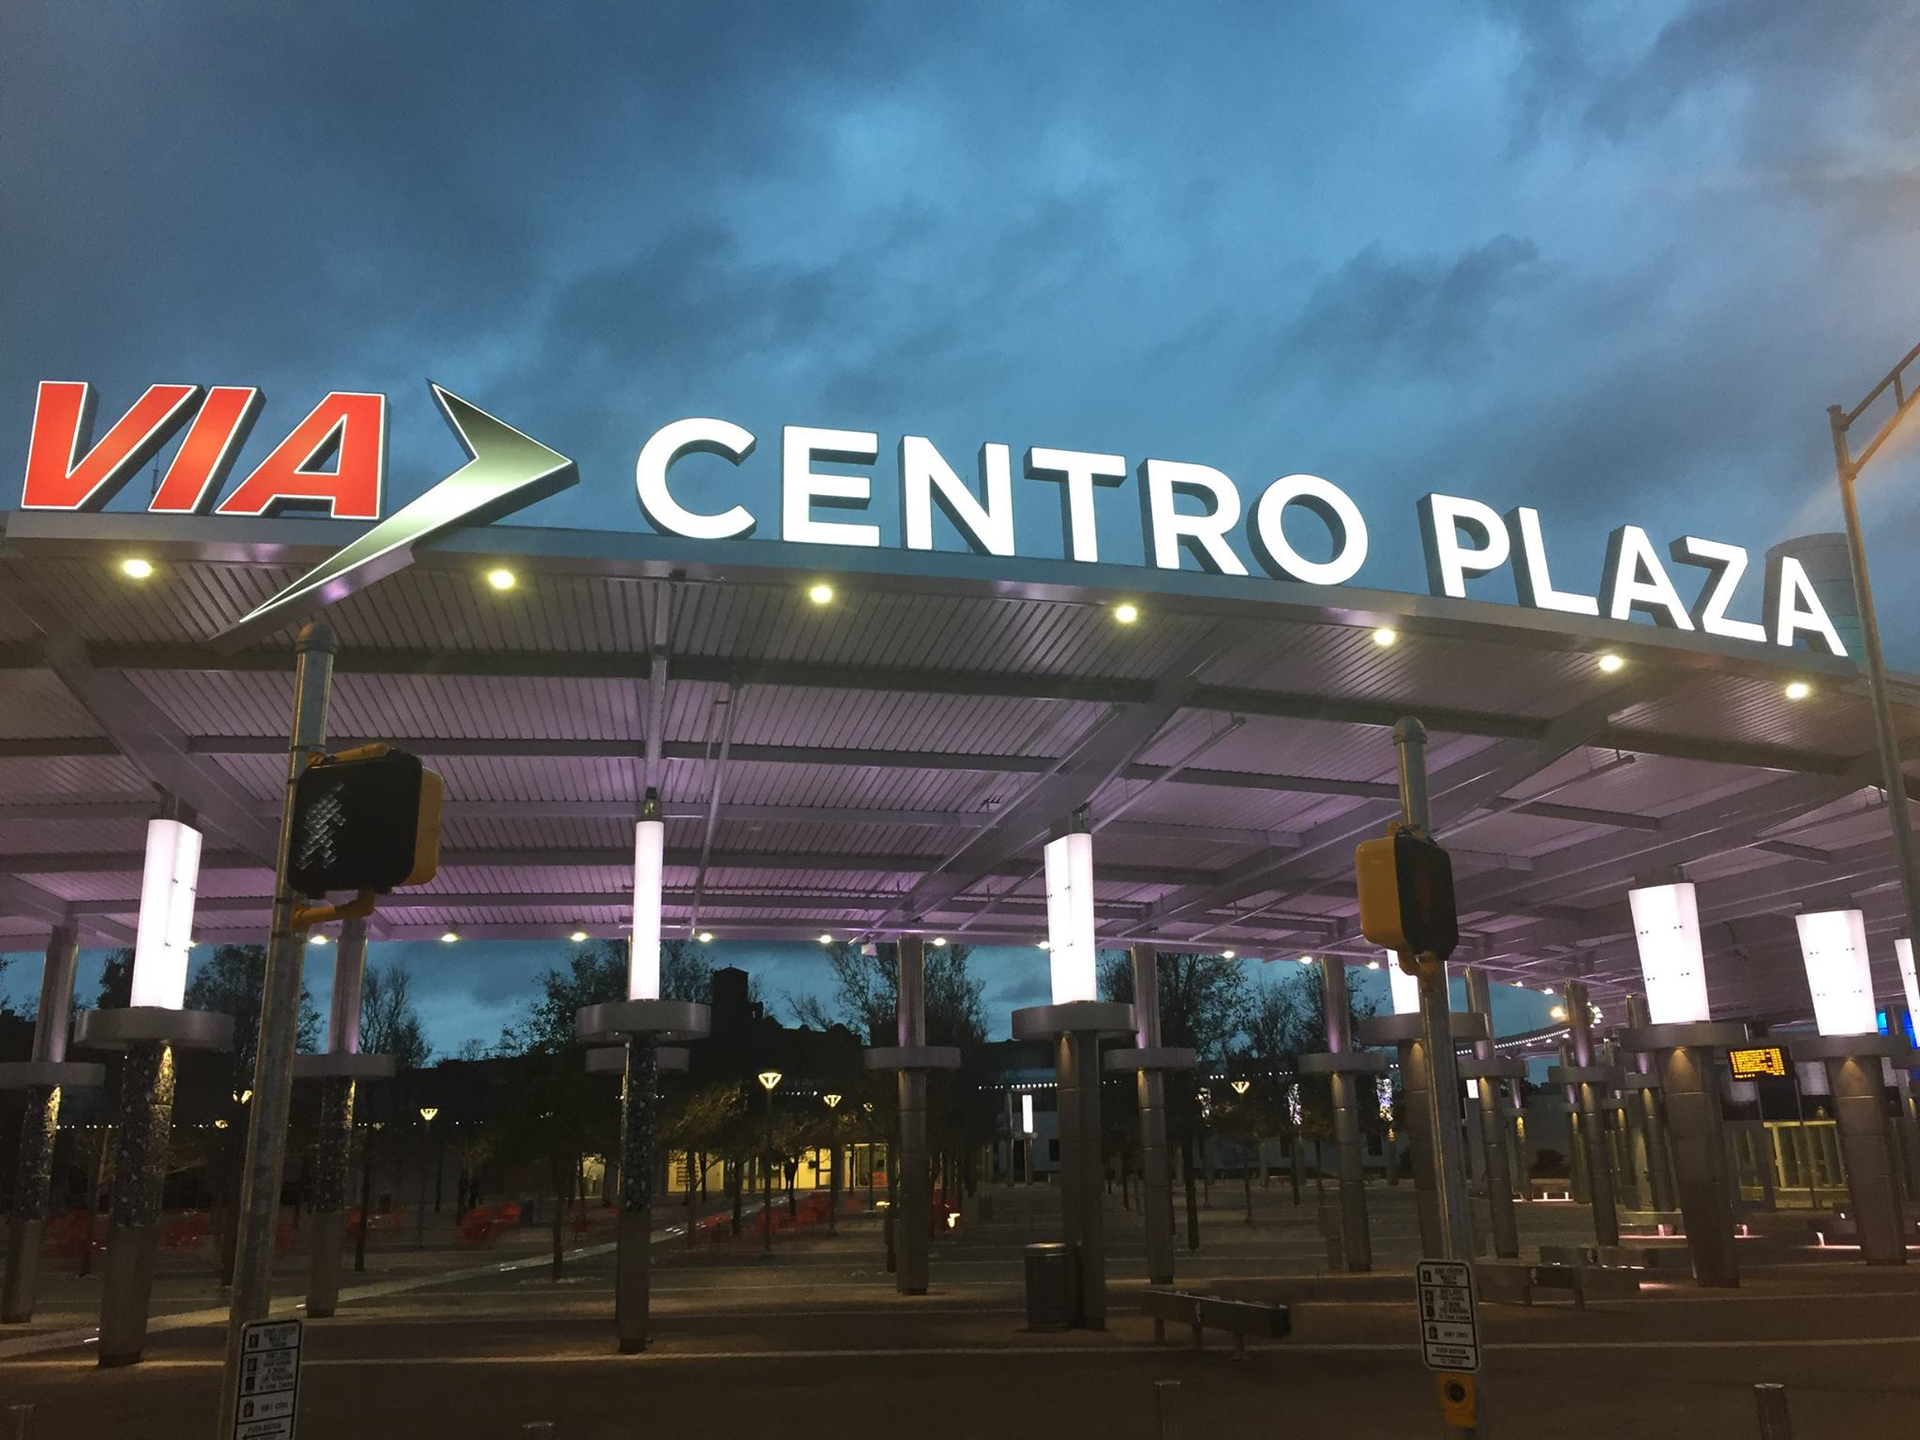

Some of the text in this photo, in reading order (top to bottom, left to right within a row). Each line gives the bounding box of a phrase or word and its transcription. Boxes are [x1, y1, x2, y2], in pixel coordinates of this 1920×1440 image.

[20, 380, 1850, 657] VIA CENTRO PLAZA
